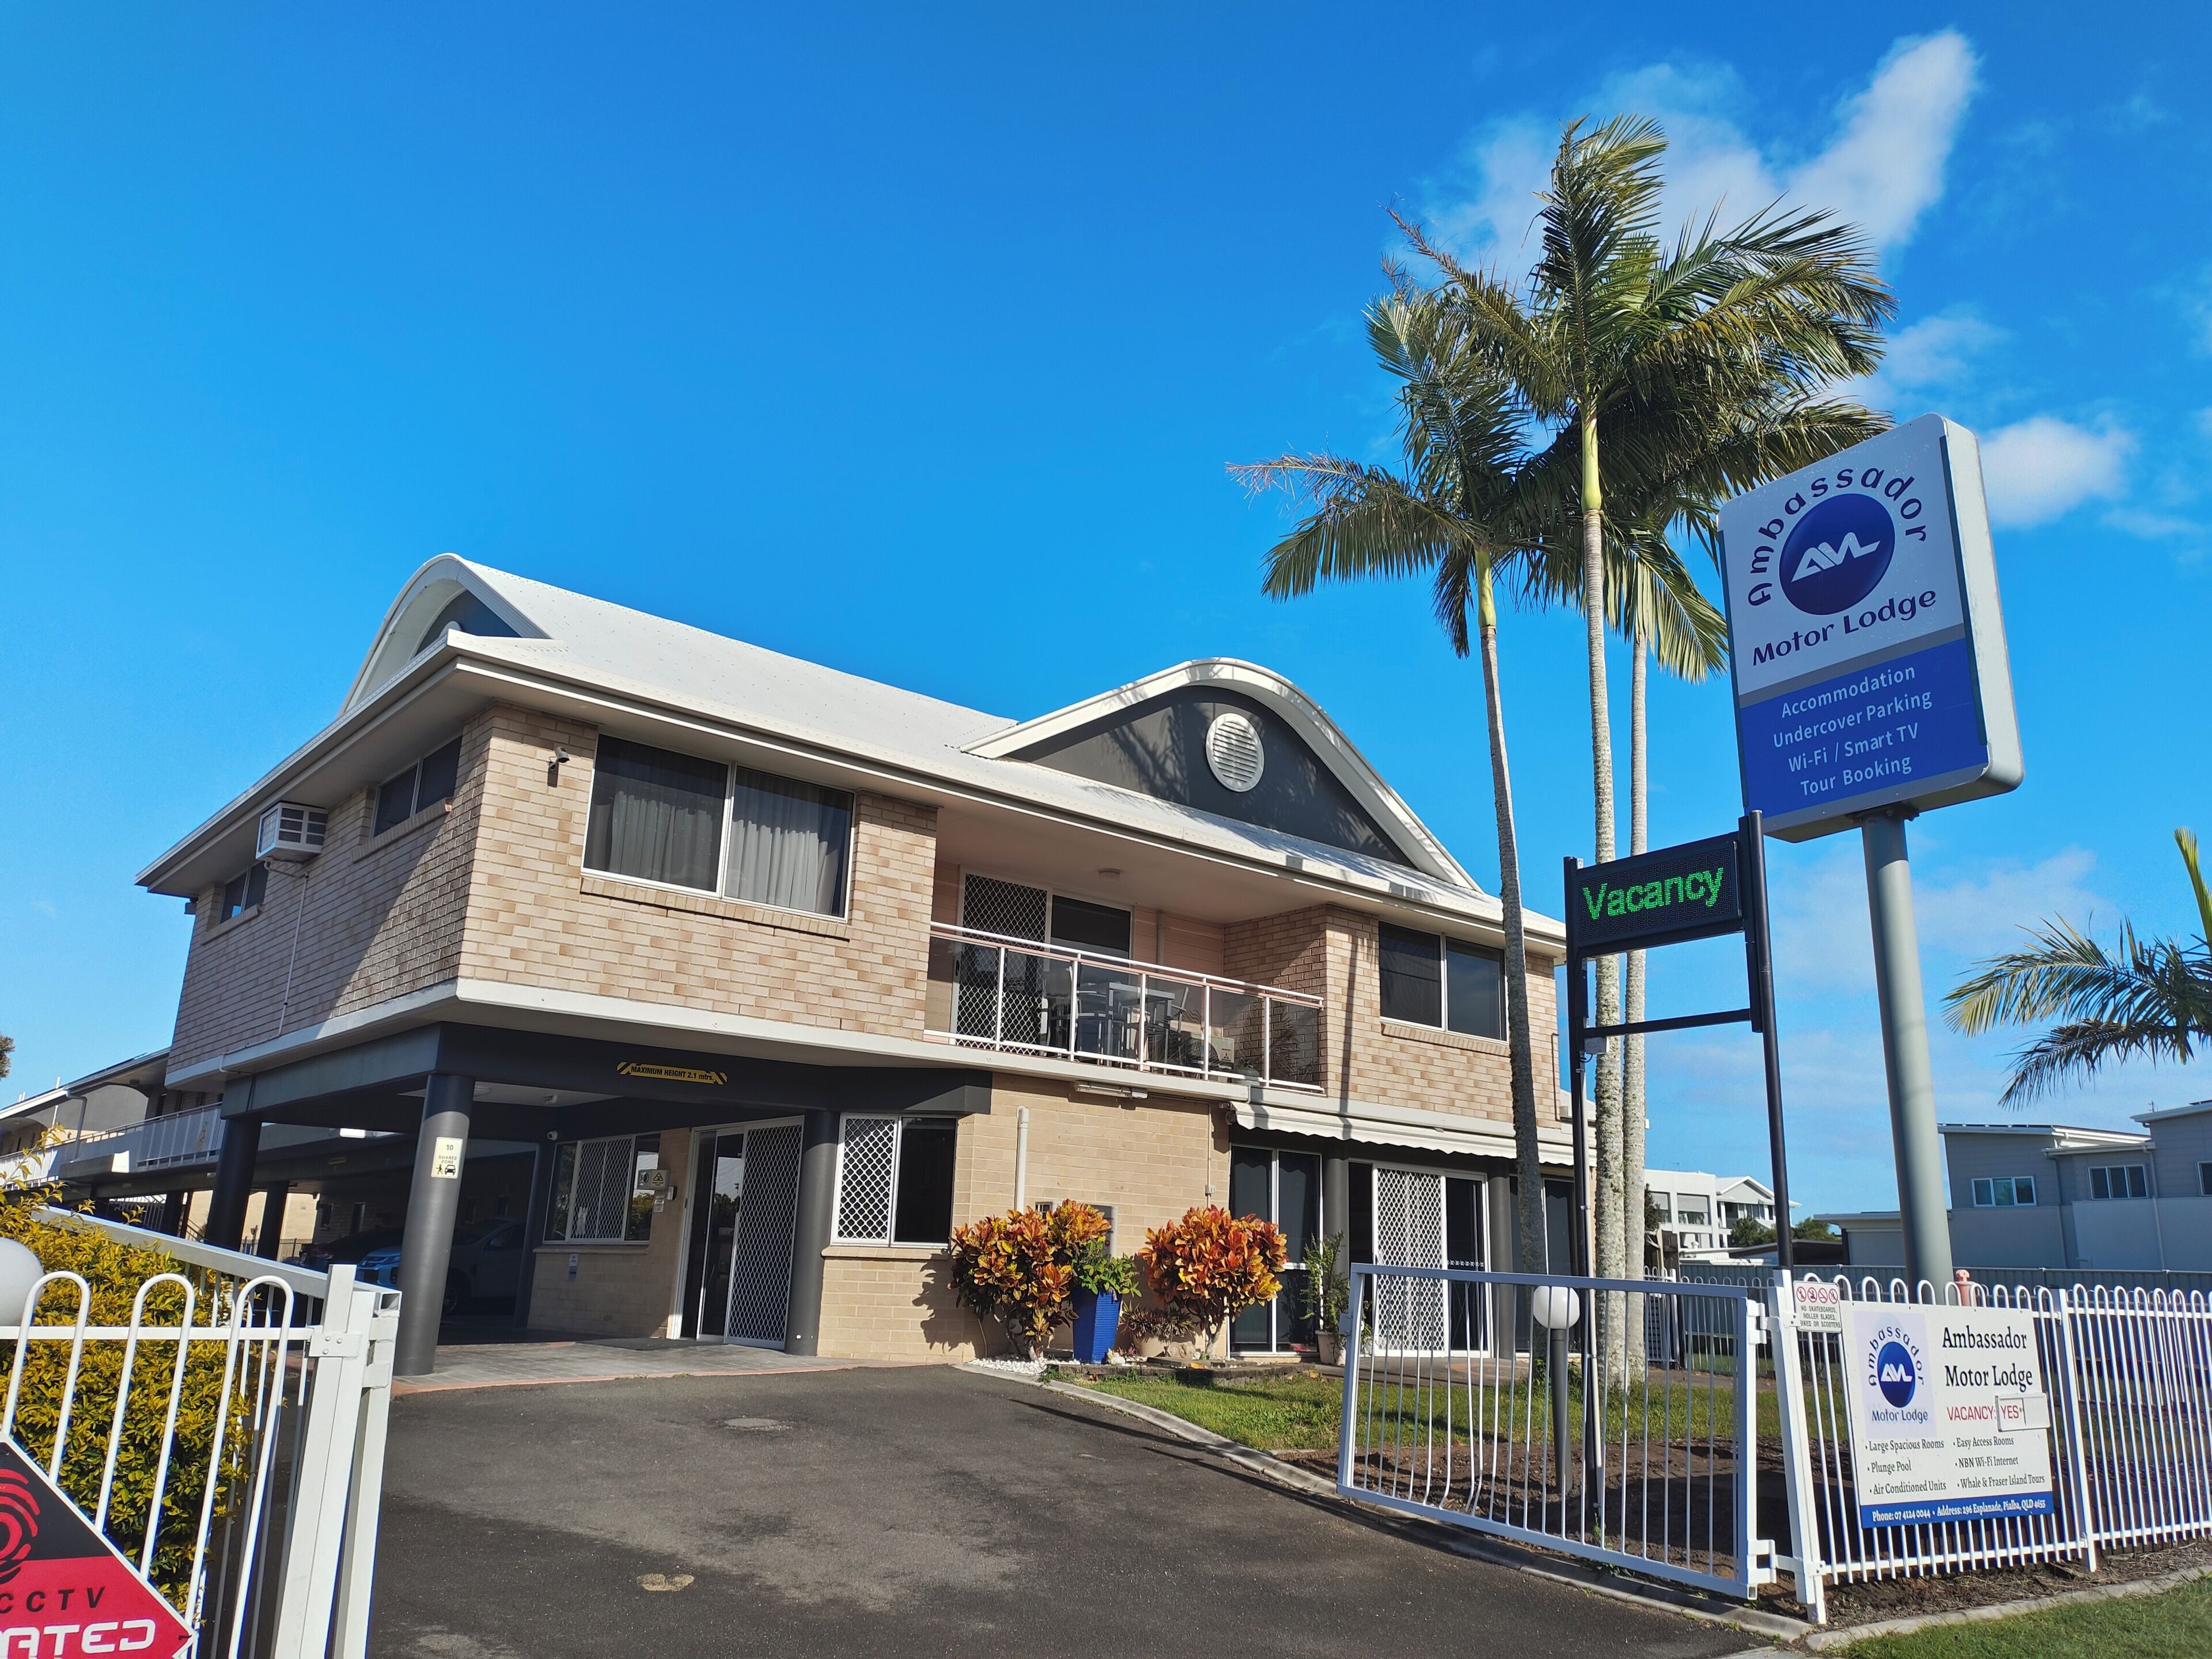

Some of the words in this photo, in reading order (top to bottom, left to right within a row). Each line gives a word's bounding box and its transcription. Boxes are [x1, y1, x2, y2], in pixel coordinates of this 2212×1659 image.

[1748, 468, 1926, 606] Ambassador
[1753, 624, 1834, 665] Motor
[1843, 590, 1936, 634] Lodge
[1782, 667, 1915, 718] Accommodation
[1774, 711, 1862, 748] Undercover
[1866, 692, 1932, 721] Parking
[1788, 747, 1827, 772] Wi-Fi
[1844, 730, 1893, 757] Smart
[1896, 722, 1918, 742] TV
[1800, 776, 1836, 796] Tour
[1843, 757, 1912, 785] Booking
[1582, 868, 1724, 920] Vacancy
[631, 1066, 662, 1075] MAXIMUM
[1942, 1325, 2027, 1349] Ambassador
[1944, 1365, 1988, 1387] Motor
[1992, 1362, 2033, 1392] Lodge
[1872, 1409, 1899, 1422] Motor
[1901, 1410, 1928, 1424] Lodge
[2001, 1405, 2020, 1419] YES
[1869, 1441, 1888, 1453] Large
[1890, 1440, 1920, 1453] Spacious
[1921, 1439, 1944, 1449] Rooms
[1956, 1437, 1971, 1450] Easy
[1972, 1437, 1992, 1446] Access
[1994, 1436, 2014, 1445] Rooms
[1871, 1461, 1895, 1475] Plunge
[1896, 1460, 1911, 1471] Pool
[1959, 1457, 1974, 1468] NBN
[1975, 1456, 1993, 1467] Wi-Fi
[1994, 1456, 2018, 1467] Internet
[1873, 1483, 1884, 1495] Air
[1885, 1480, 1927, 1494] Conditioned
[1928, 1479, 1946, 1491] Units
[1960, 1477, 1981, 1488] Whale
[1982, 1478, 1987, 1487] &
[1988, 1476, 2008, 1487] Fraser
[2009, 1474, 2027, 1485] Island
[2028, 1474, 2045, 1484] Tours
[1872, 1510, 1894, 1522] Phone:
[1895, 1510, 1902, 1521] 07
[1902, 1510, 1915, 1520] 4124
[1916, 1509, 1930, 1518] 0044
[1937, 1505, 1962, 1516] Address:
[1963, 1506, 1972, 1515] 296
[1973, 1501, 2003, 1516] Esplanade,
[2003, 1499, 2021, 1511] Pialba,
[2021, 1499, 2033, 1511] QLD
[0, 1586, 105, 1613] CCTV
[0, 1619, 156, 1657] ATED
